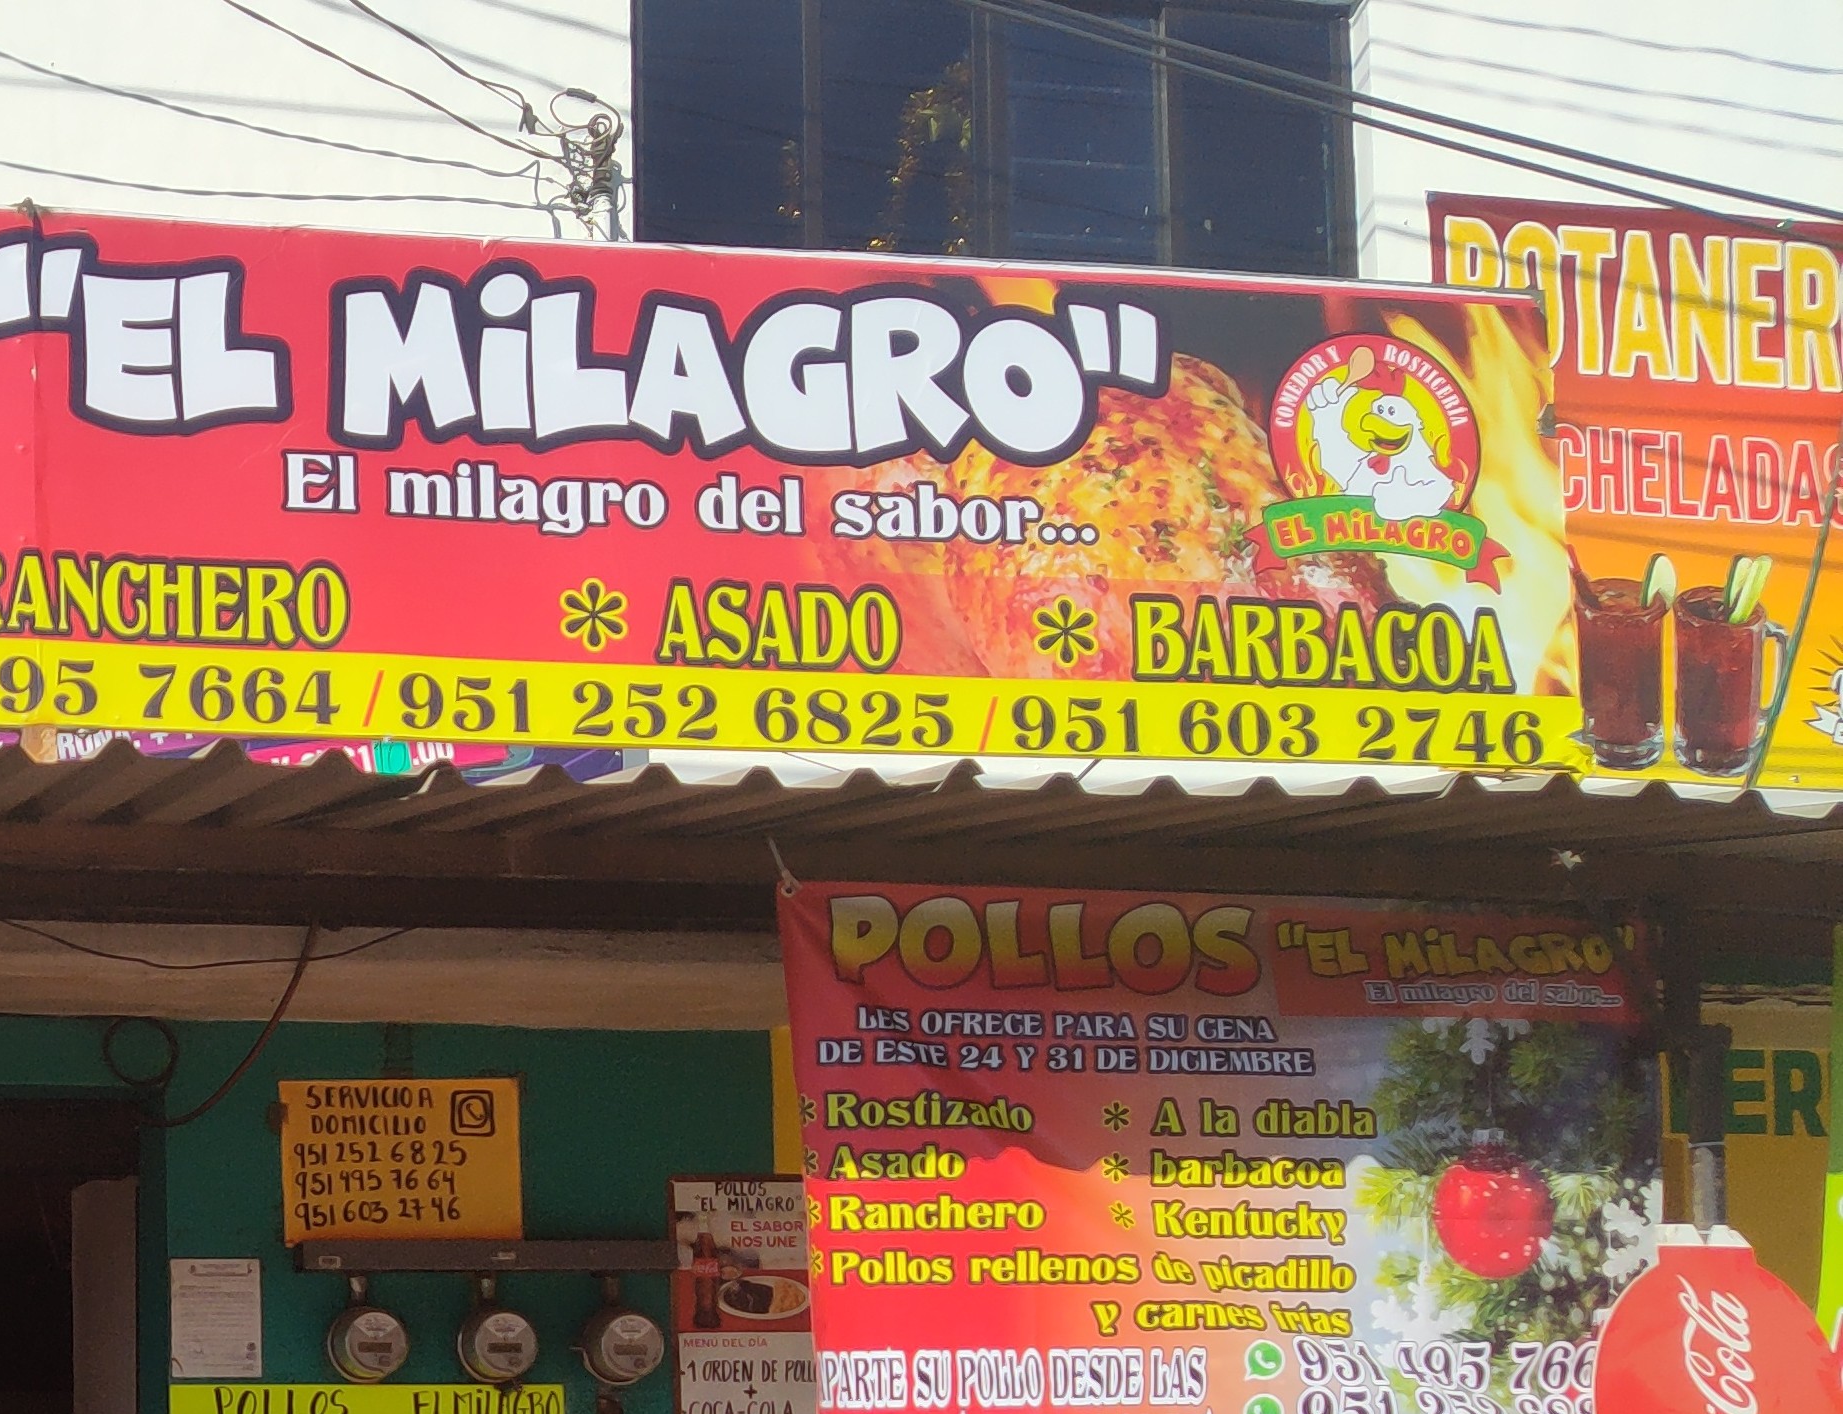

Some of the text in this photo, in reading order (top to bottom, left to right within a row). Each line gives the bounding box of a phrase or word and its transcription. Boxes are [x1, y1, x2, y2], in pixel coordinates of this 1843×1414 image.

[1275, 343, 1469, 428] COMEDOR Y ROSTICERÍA
[284, 450, 1099, 545] El milagro del sabor...
[1273, 516, 1315, 549] EL
[657, 579, 902, 671] ASADO
[1131, 594, 1517, 692] BARBACOA
[138, 661, 342, 727] 7664
[398, 671, 532, 734] 951
[572, 680, 719, 741] 252
[753, 686, 955, 750] 6825
[1011, 694, 1141, 753] 951
[1179, 698, 1321, 758] 603
[1355, 705, 1545, 765] 2746
[829, 895, 1262, 996] POLLOS
[306, 1085, 434, 1110] SERVICIO A
[826, 1090, 1377, 1138] Rostizado diabla
[311, 1114, 427, 1136] DOMICILIO
[293, 1140, 383, 1168] 951 252
[828, 1143, 1346, 1189] Asado barbacoa
[295, 1169, 383, 1199] 951 495
[294, 1199, 389, 1231] 951 603
[730, 1220, 804, 1232] EL SABOR
[828, 1194, 1347, 1245] Ranchero Kentucky
[730, 1235, 797, 1248] NOS UNE
[830, 1249, 1357, 1295] Pollos rellenos picadillo
[702, 1359, 779, 1382] ORDEN DE
